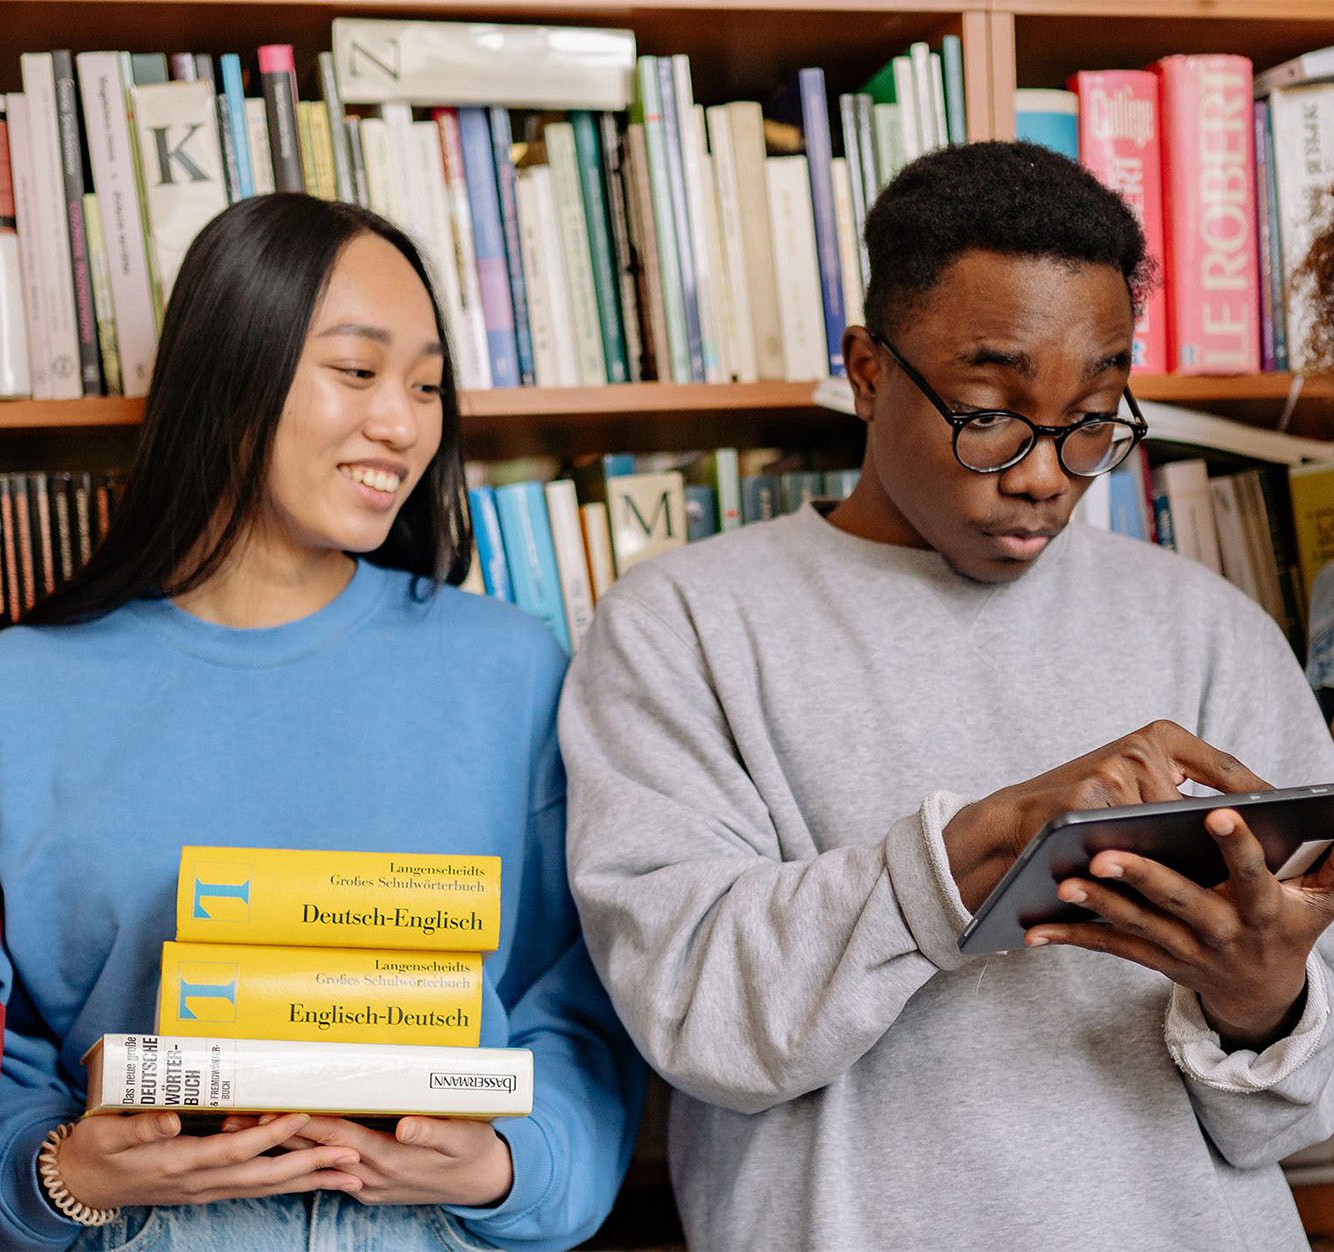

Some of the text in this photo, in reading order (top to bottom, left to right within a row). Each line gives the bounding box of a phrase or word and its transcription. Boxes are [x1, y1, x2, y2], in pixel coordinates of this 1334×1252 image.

[146, 122, 210, 187] K
[1198, 66, 1250, 367] LE ROBERT
[622, 491, 674, 540] M
[330, 874, 485, 893] Großes Schulwörterbuch
[390, 862, 485, 877] Langenscheidts
[301, 903, 484, 935] Deutsch-Englisch
[316, 972, 470, 990] Großes Schulwörterbuch
[375, 959, 471, 973] Langenscheidts
[288, 1003, 469, 1030] Englisch-Deutsch
[122, 1036, 138, 1105] Das neue große
[140, 1037, 158, 1105] DEUTSCHE
[161, 1044, 183, 1106] WÖRTER-
[183, 1069, 201, 1106] BUCH
[221, 1080, 231, 1100] BUCH
